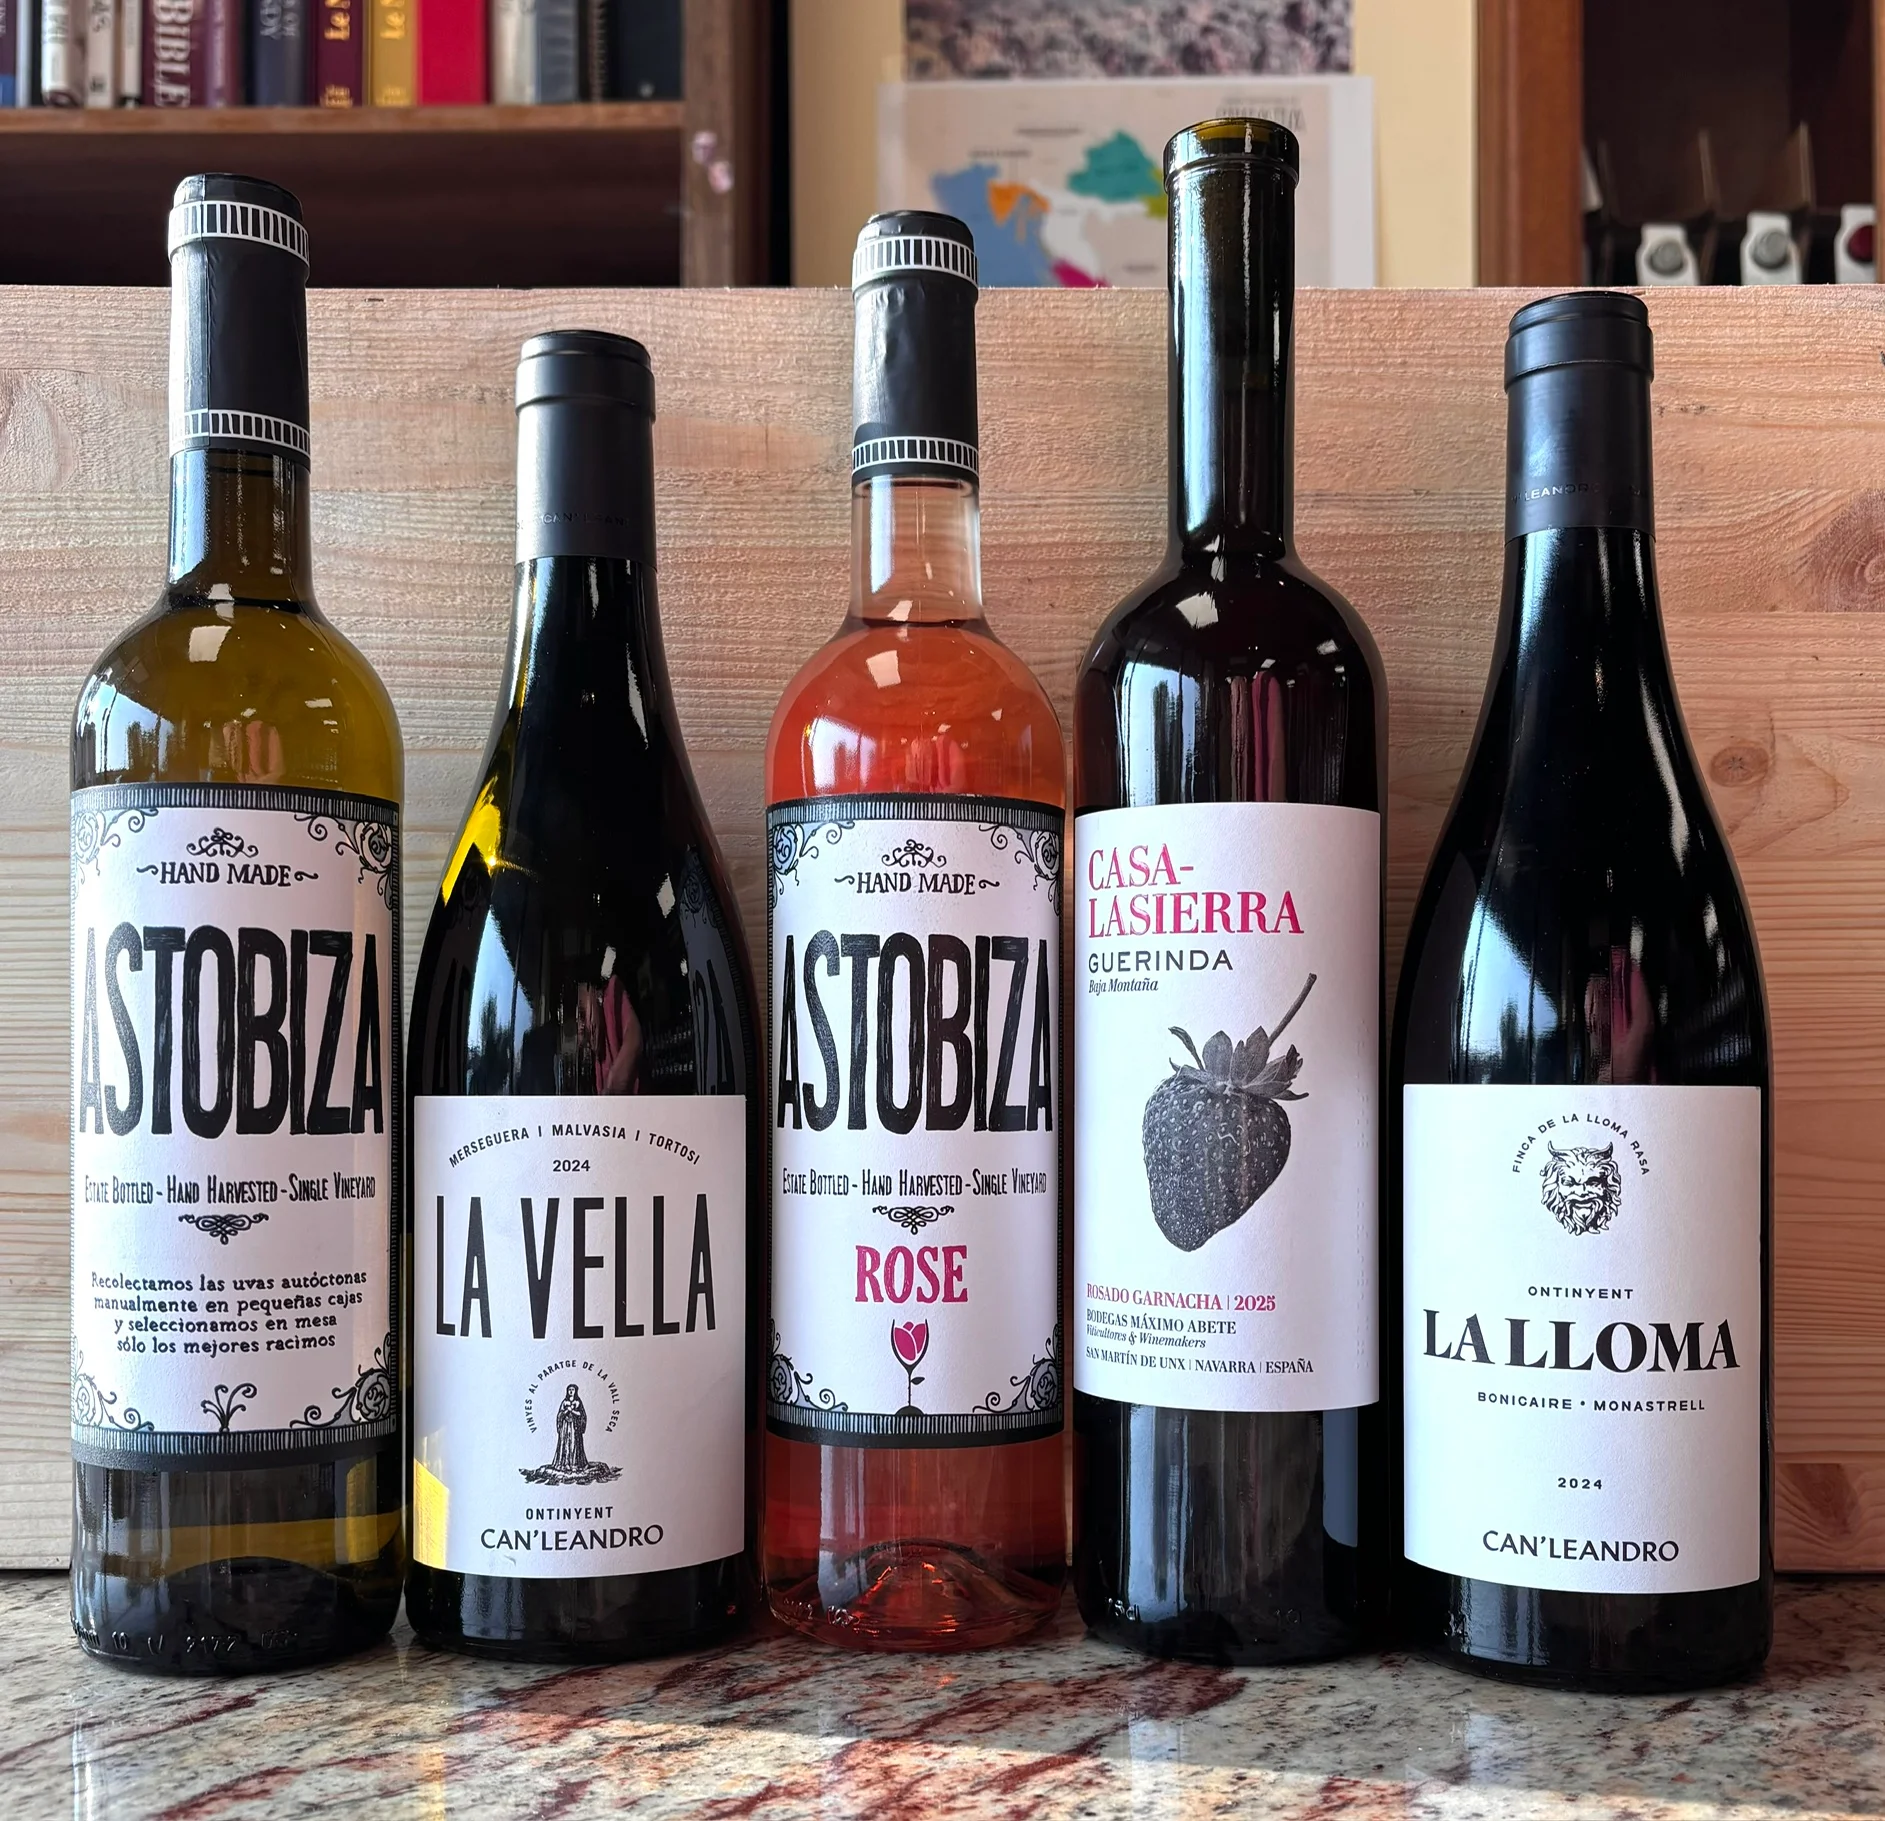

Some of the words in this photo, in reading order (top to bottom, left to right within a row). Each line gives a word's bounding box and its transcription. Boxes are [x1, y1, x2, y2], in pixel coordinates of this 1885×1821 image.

[160, 862, 220, 884] HAND
[227, 864, 291, 887] MADE
[1089, 843, 1194, 891] CASA-
[857, 872, 911, 893] HAND
[919, 874, 975, 895] MADE
[1089, 890, 1304, 939] LASIERRA
[1089, 949, 1233, 974] GUERINDA
[1088, 978, 1107, 996] Baja
[1108, 977, 1158, 993] Montaña
[80, 921, 384, 1139] ASTOBIZA
[777, 930, 1053, 1134] ASTOBIZA
[449, 1127, 530, 1168] MERSEGUERA
[552, 1124, 626, 1140] MALVASIA
[649, 1132, 700, 1165] TORTOSI
[1512, 1135, 1536, 1173] FINCA
[1538, 1119, 1556, 1134] DE
[1562, 1113, 1579, 1124] LA
[1586, 1113, 1629, 1139] LLOMA
[1630, 1140, 1650, 1176] RASA
[552, 1159, 591, 1173] 2024
[783, 1168, 806, 1194] ESTATE
[810, 1169, 849, 1196] BOTTLED
[862, 1169, 892, 1196] HAND
[899, 1169, 962, 1197] HARVESTED
[973, 1168, 1007, 1195] SINGLE
[1012, 1167, 1047, 1194] VINEYARD
[436, 1195, 492, 1339] LA
[520, 1193, 716, 1340] VELLA
[855, 1245, 968, 1303] ROSE
[91, 1271, 193, 1292] Recolectamos
[200, 1273, 225, 1292] las
[233, 1277, 274, 1290] uvas
[281, 1271, 367, 1290] autóctonas
[1527, 1286, 1634, 1300] ONTINYENT
[94, 1295, 198, 1313] manualmente
[205, 1300, 229, 1313] en
[237, 1294, 322, 1316] pequeñas
[327, 1291, 363, 1309] cajas
[1086, 1283, 1130, 1304] ROSADO
[1132, 1289, 1222, 1311] GARNACHA
[1234, 1295, 1276, 1312] 2025
[114, 1318, 124, 1334] y
[127, 1316, 258, 1332] seleccionamos
[265, 1318, 288, 1330] en
[295, 1314, 338, 1329] mesa
[1086, 1308, 1128, 1327] BODEGAS
[1131, 1313, 1184, 1332] MÁXIMO
[1187, 1320, 1236, 1335] ABETE
[117, 1336, 147, 1353] sólo
[152, 1336, 177, 1353] los
[183, 1338, 259, 1358] mejores
[266, 1335, 336, 1351] racimos
[1086, 1324, 1127, 1342] Viticultores
[1128, 1331, 1137, 1345] &
[1139, 1332, 1206, 1348] Winemakers
[1423, 1308, 1495, 1365] LA
[1504, 1318, 1741, 1374] LLOMA
[537, 1359, 577, 1381] PARATGE
[582, 1361, 595, 1372] DE
[1086, 1346, 1099, 1359] SAN
[1101, 1349, 1138, 1366] MARTÍN
[1140, 1354, 1157, 1368] DE
[1159, 1357, 1186, 1371] UNX
[1195, 1359, 1256, 1373] NAVARRA
[1266, 1358, 1314, 1374] ESPAÑA
[597, 1368, 609, 1381] LA
[528, 1383, 539, 1395] AL
[608, 1382, 620, 1404] VALL
[1477, 1391, 1573, 1411] BONICAIRE
[1593, 1399, 1705, 1412] MONASTRELL
[525, 1398, 537, 1433] VINYES
[605, 1409, 620, 1433] SECA
[1557, 1477, 1603, 1490] 2024
[525, 1506, 614, 1521] ONTINYENT
